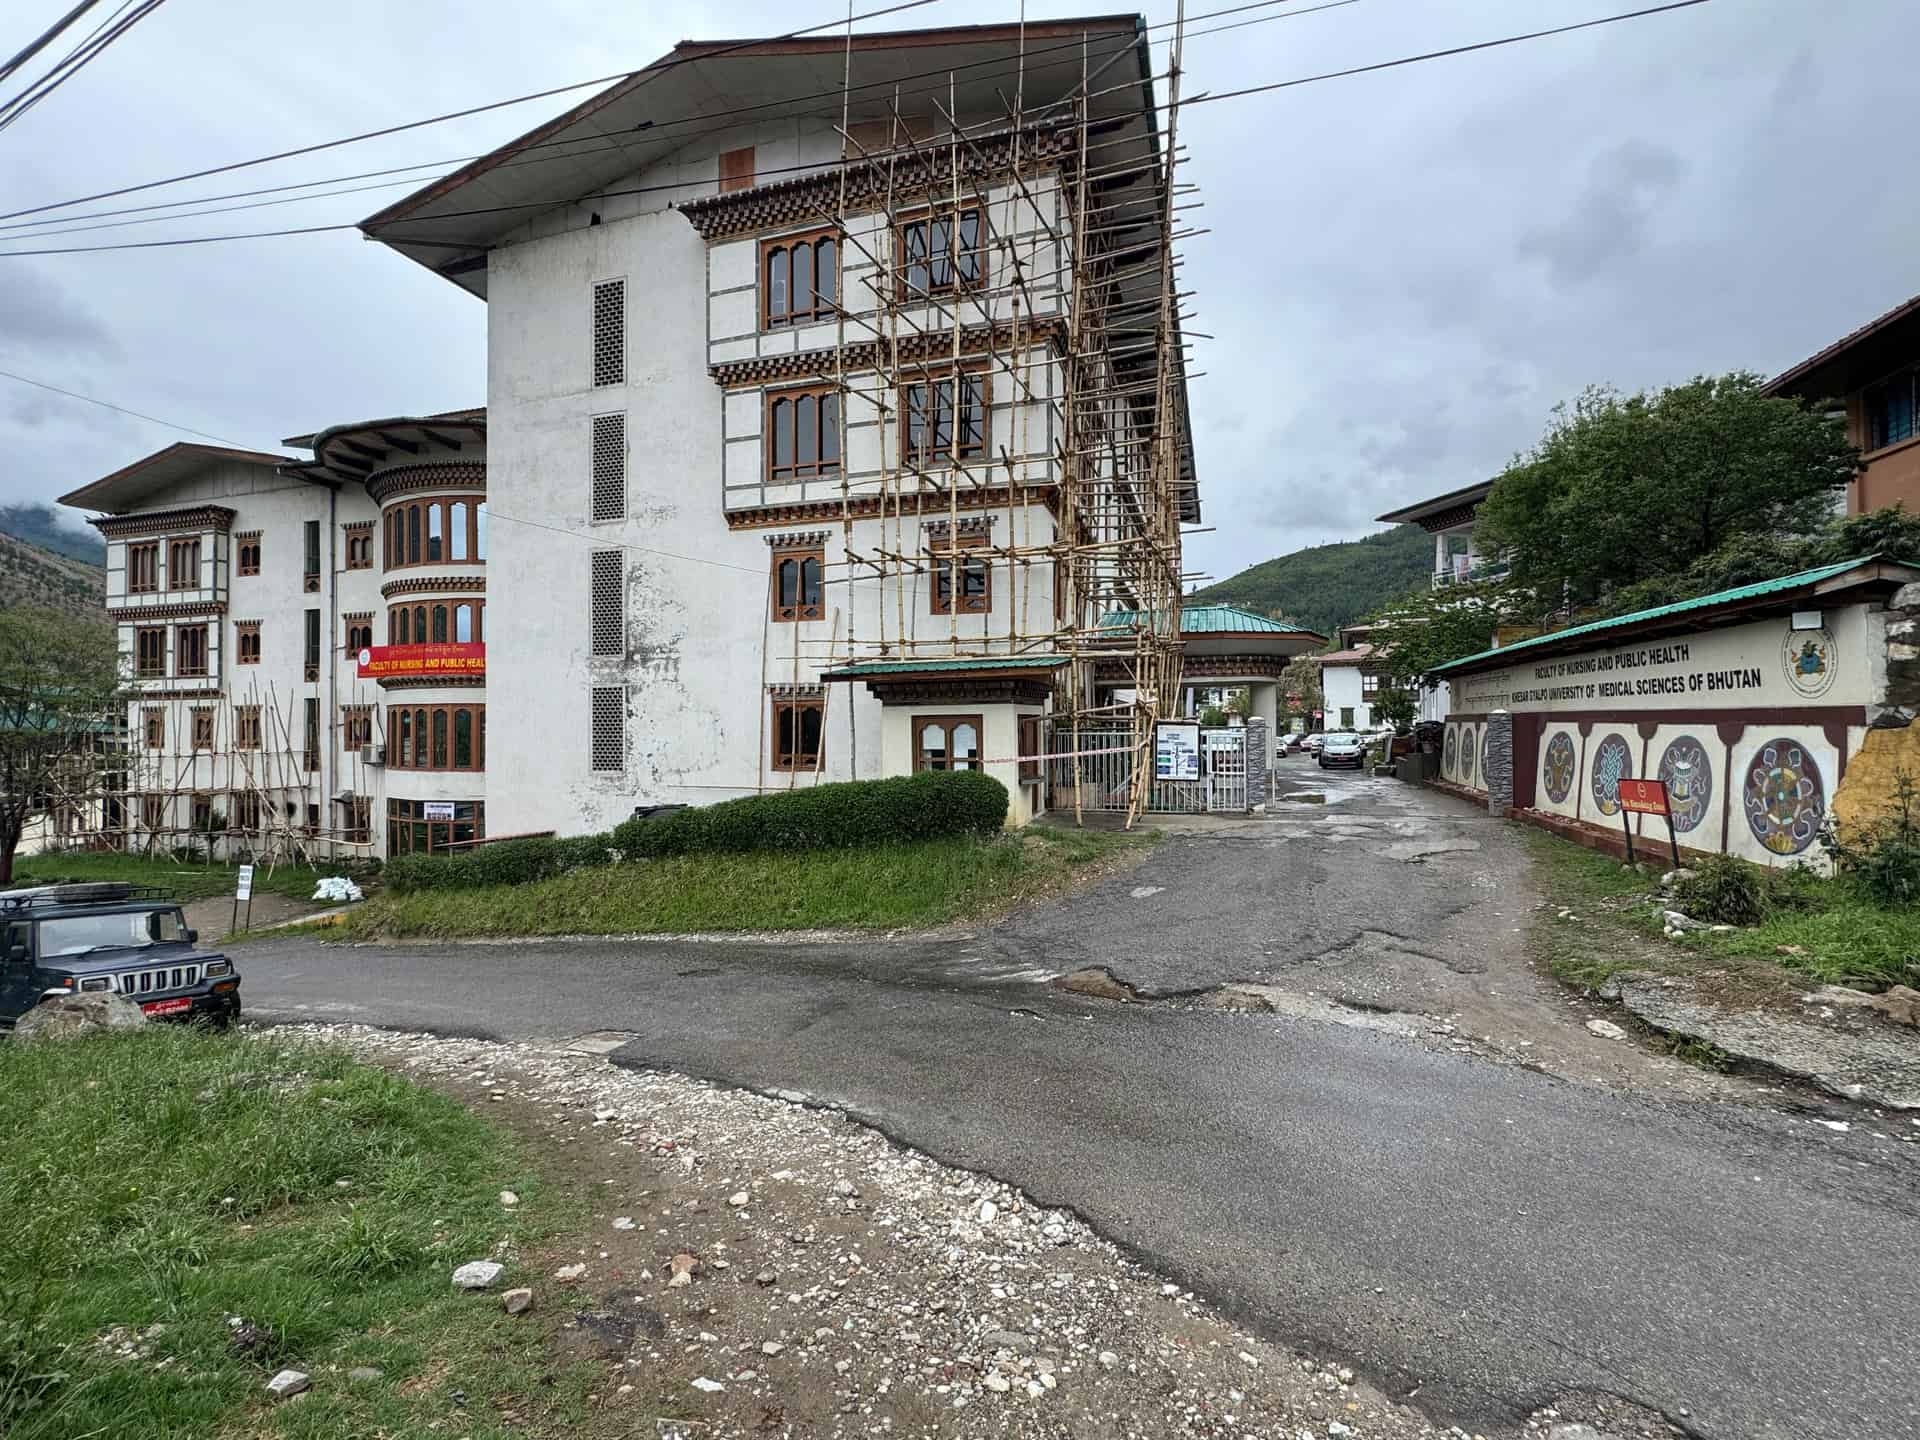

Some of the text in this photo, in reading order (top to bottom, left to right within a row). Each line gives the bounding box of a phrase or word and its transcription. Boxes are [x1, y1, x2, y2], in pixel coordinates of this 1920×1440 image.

[425, 657, 440, 668] AND
[441, 657, 465, 668] PUBLIC
[1535, 644, 1689, 680] FACULTY OF NURSING AND PUBLIC HEALTH
[1549, 685, 1584, 701] UNIVERSITY
[1586, 683, 1595, 698] OF
[1599, 680, 1635, 697] MEDICAL
[1637, 675, 1685, 695] SCIENCES
[1689, 673, 1703, 691] OF
[1707, 668, 1762, 690] BHUTAN
